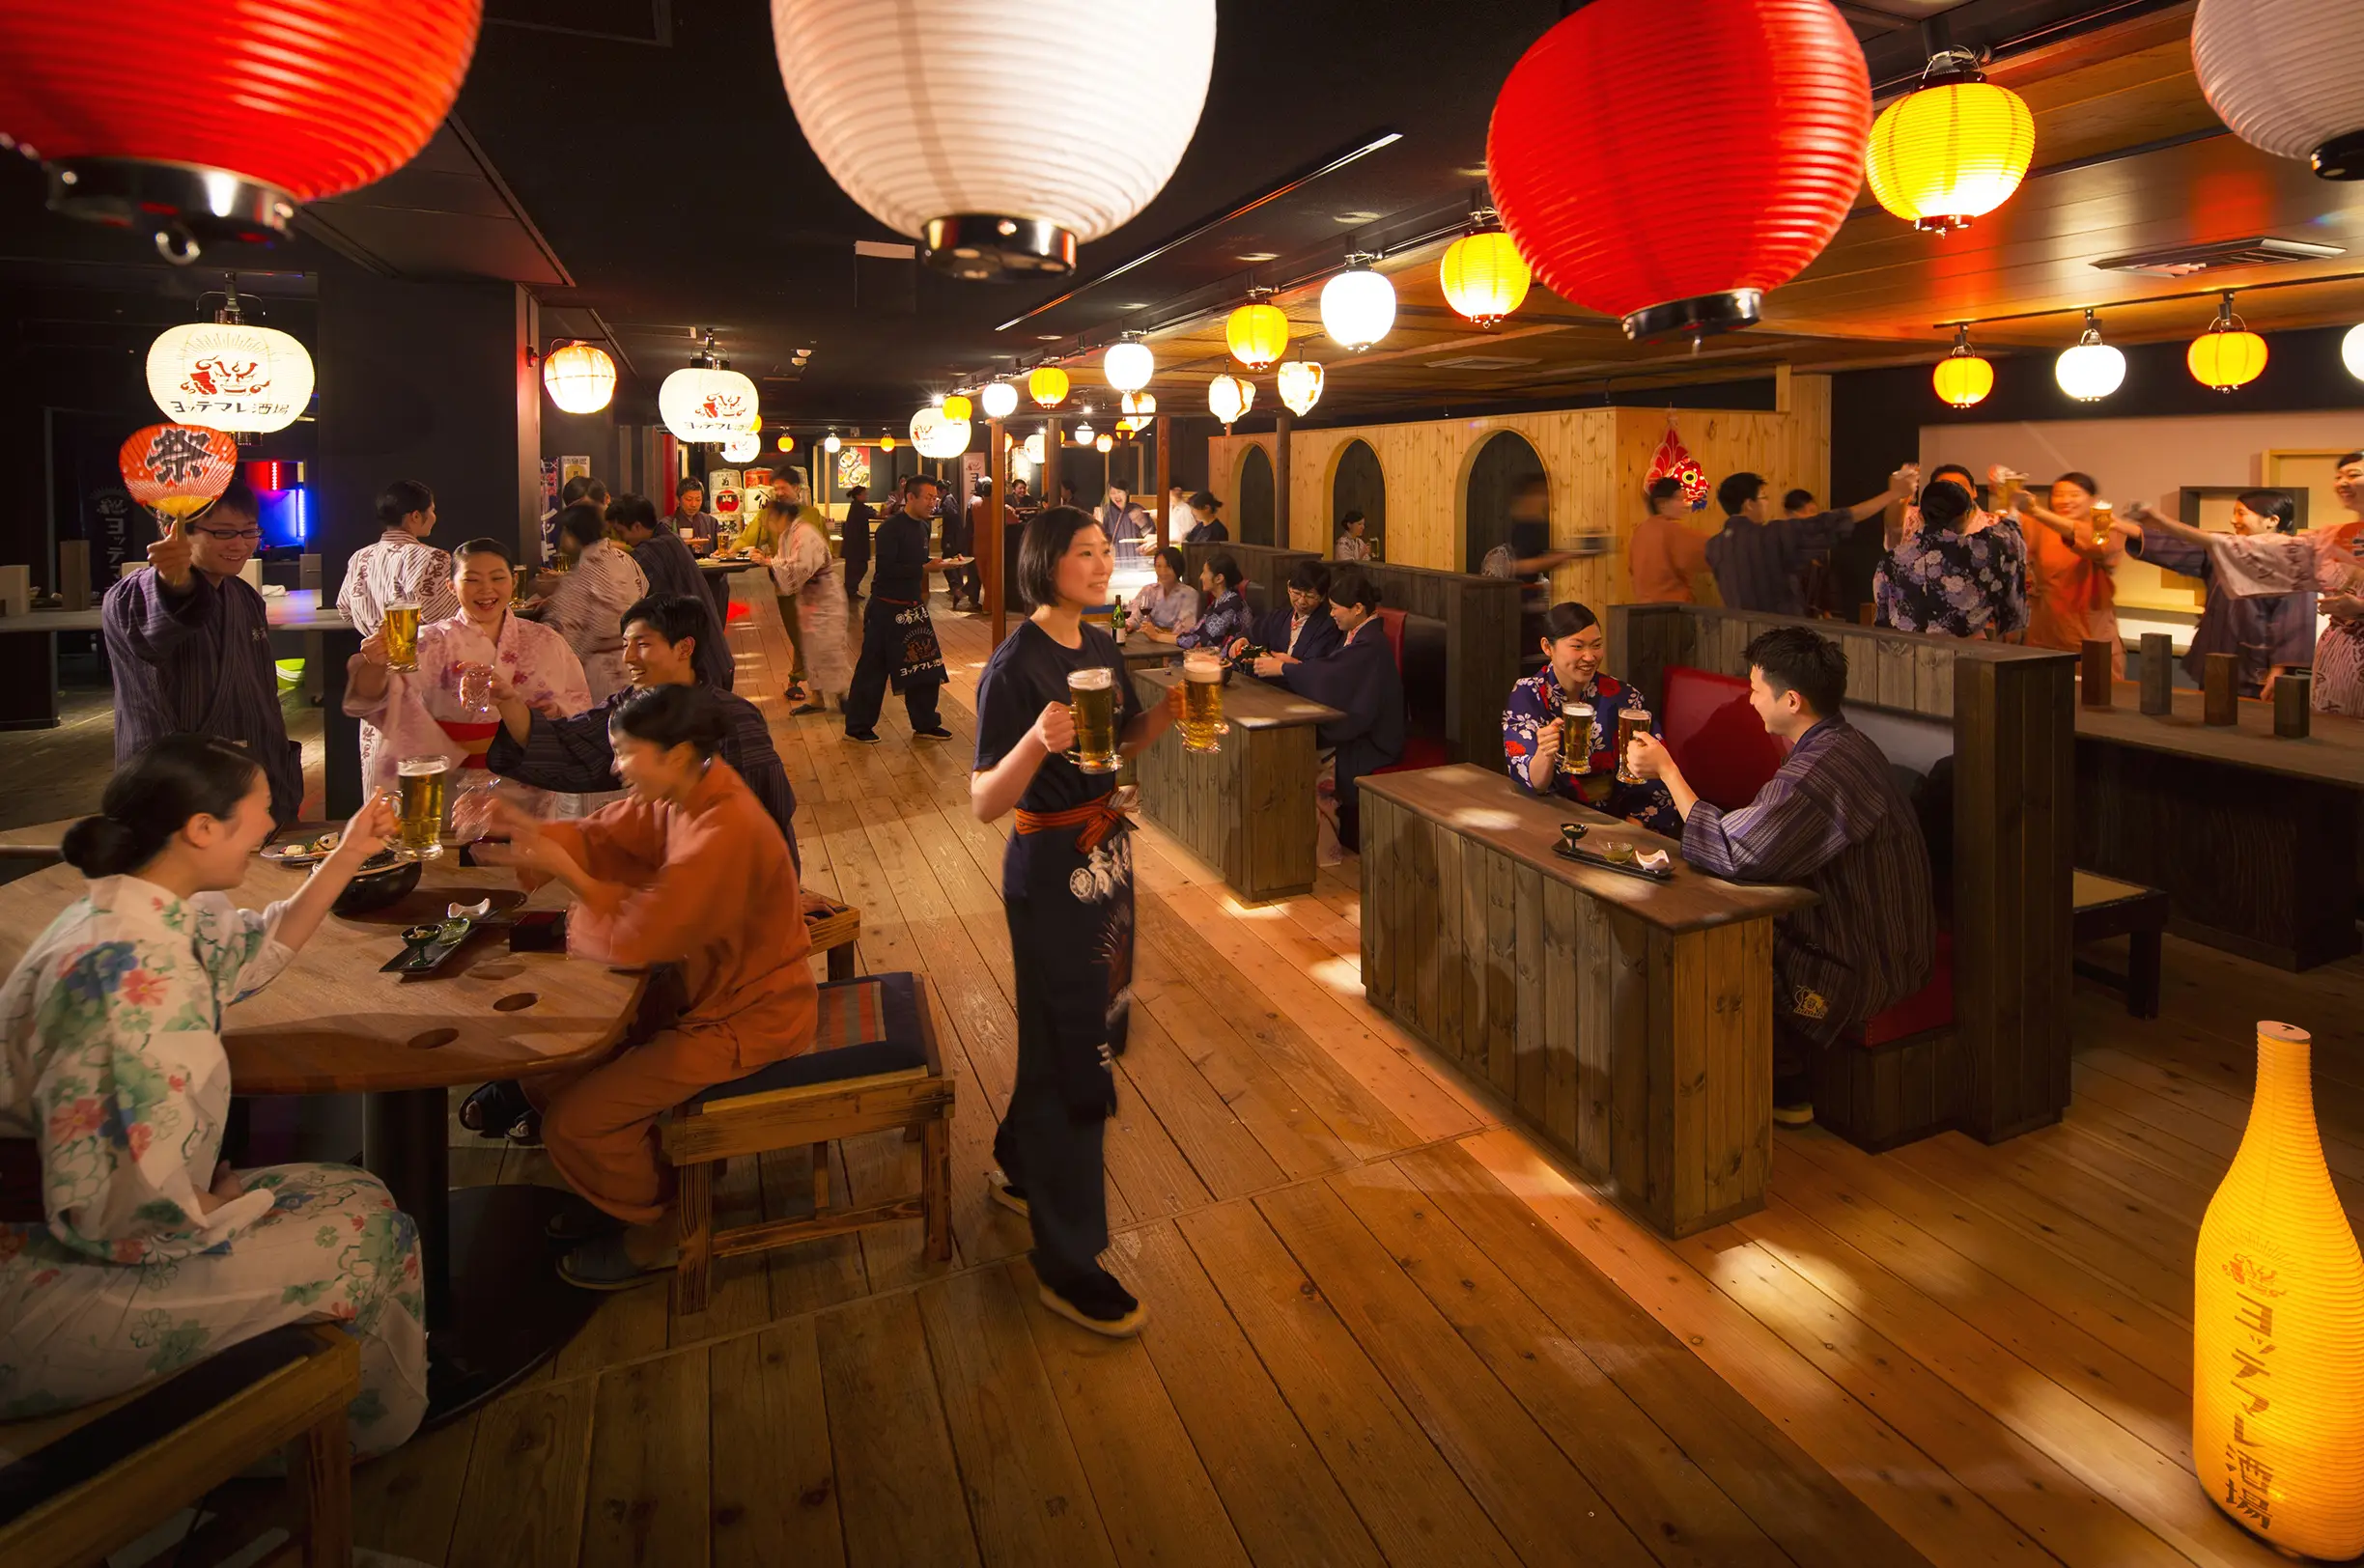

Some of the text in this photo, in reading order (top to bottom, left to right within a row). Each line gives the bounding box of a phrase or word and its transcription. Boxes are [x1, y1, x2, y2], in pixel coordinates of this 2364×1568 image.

[170, 401, 290, 415] ヨッテマレ酒場
[146, 429, 214, 483] 祭
[2225, 1291, 2277, 1530] ヨッテマレ酒場
